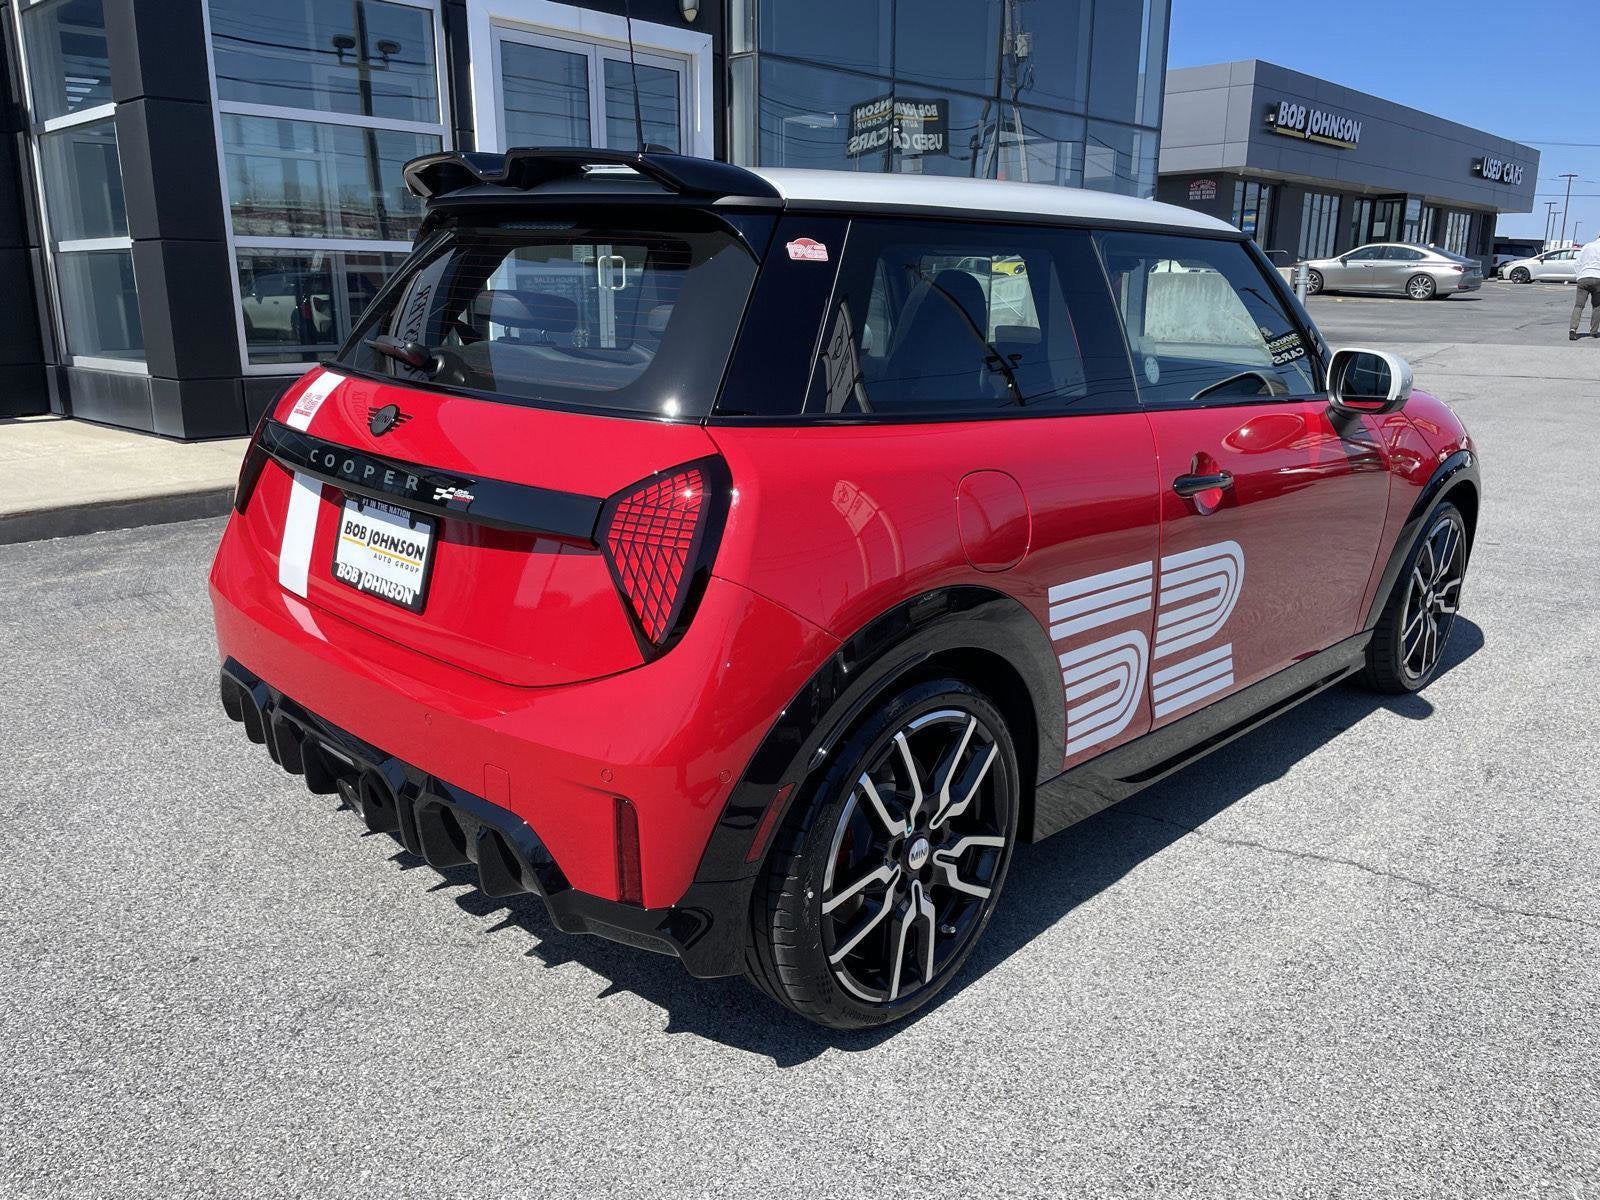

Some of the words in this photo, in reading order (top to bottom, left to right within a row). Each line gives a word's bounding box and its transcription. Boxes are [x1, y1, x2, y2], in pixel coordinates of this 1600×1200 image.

[1278, 101, 1306, 129] BOB
[1306, 109, 1361, 143] JOHNSON
[1483, 156, 1502, 180] USED
[1504, 162, 1523, 185] CARS
[310, 449, 418, 491] COOPER
[370, 500, 377, 508] IN
[377, 502, 388, 512] THE
[388, 505, 411, 519] NATION
[344, 520, 367, 540] BOB
[367, 529, 425, 561] JOHNSON
[373, 553, 392, 564] AUTO
[395, 560, 420, 574] GROUP
[336, 562, 361, 583] BOB
[358, 571, 415, 605] JOHNSON
[910, 847, 928, 862] MINI
